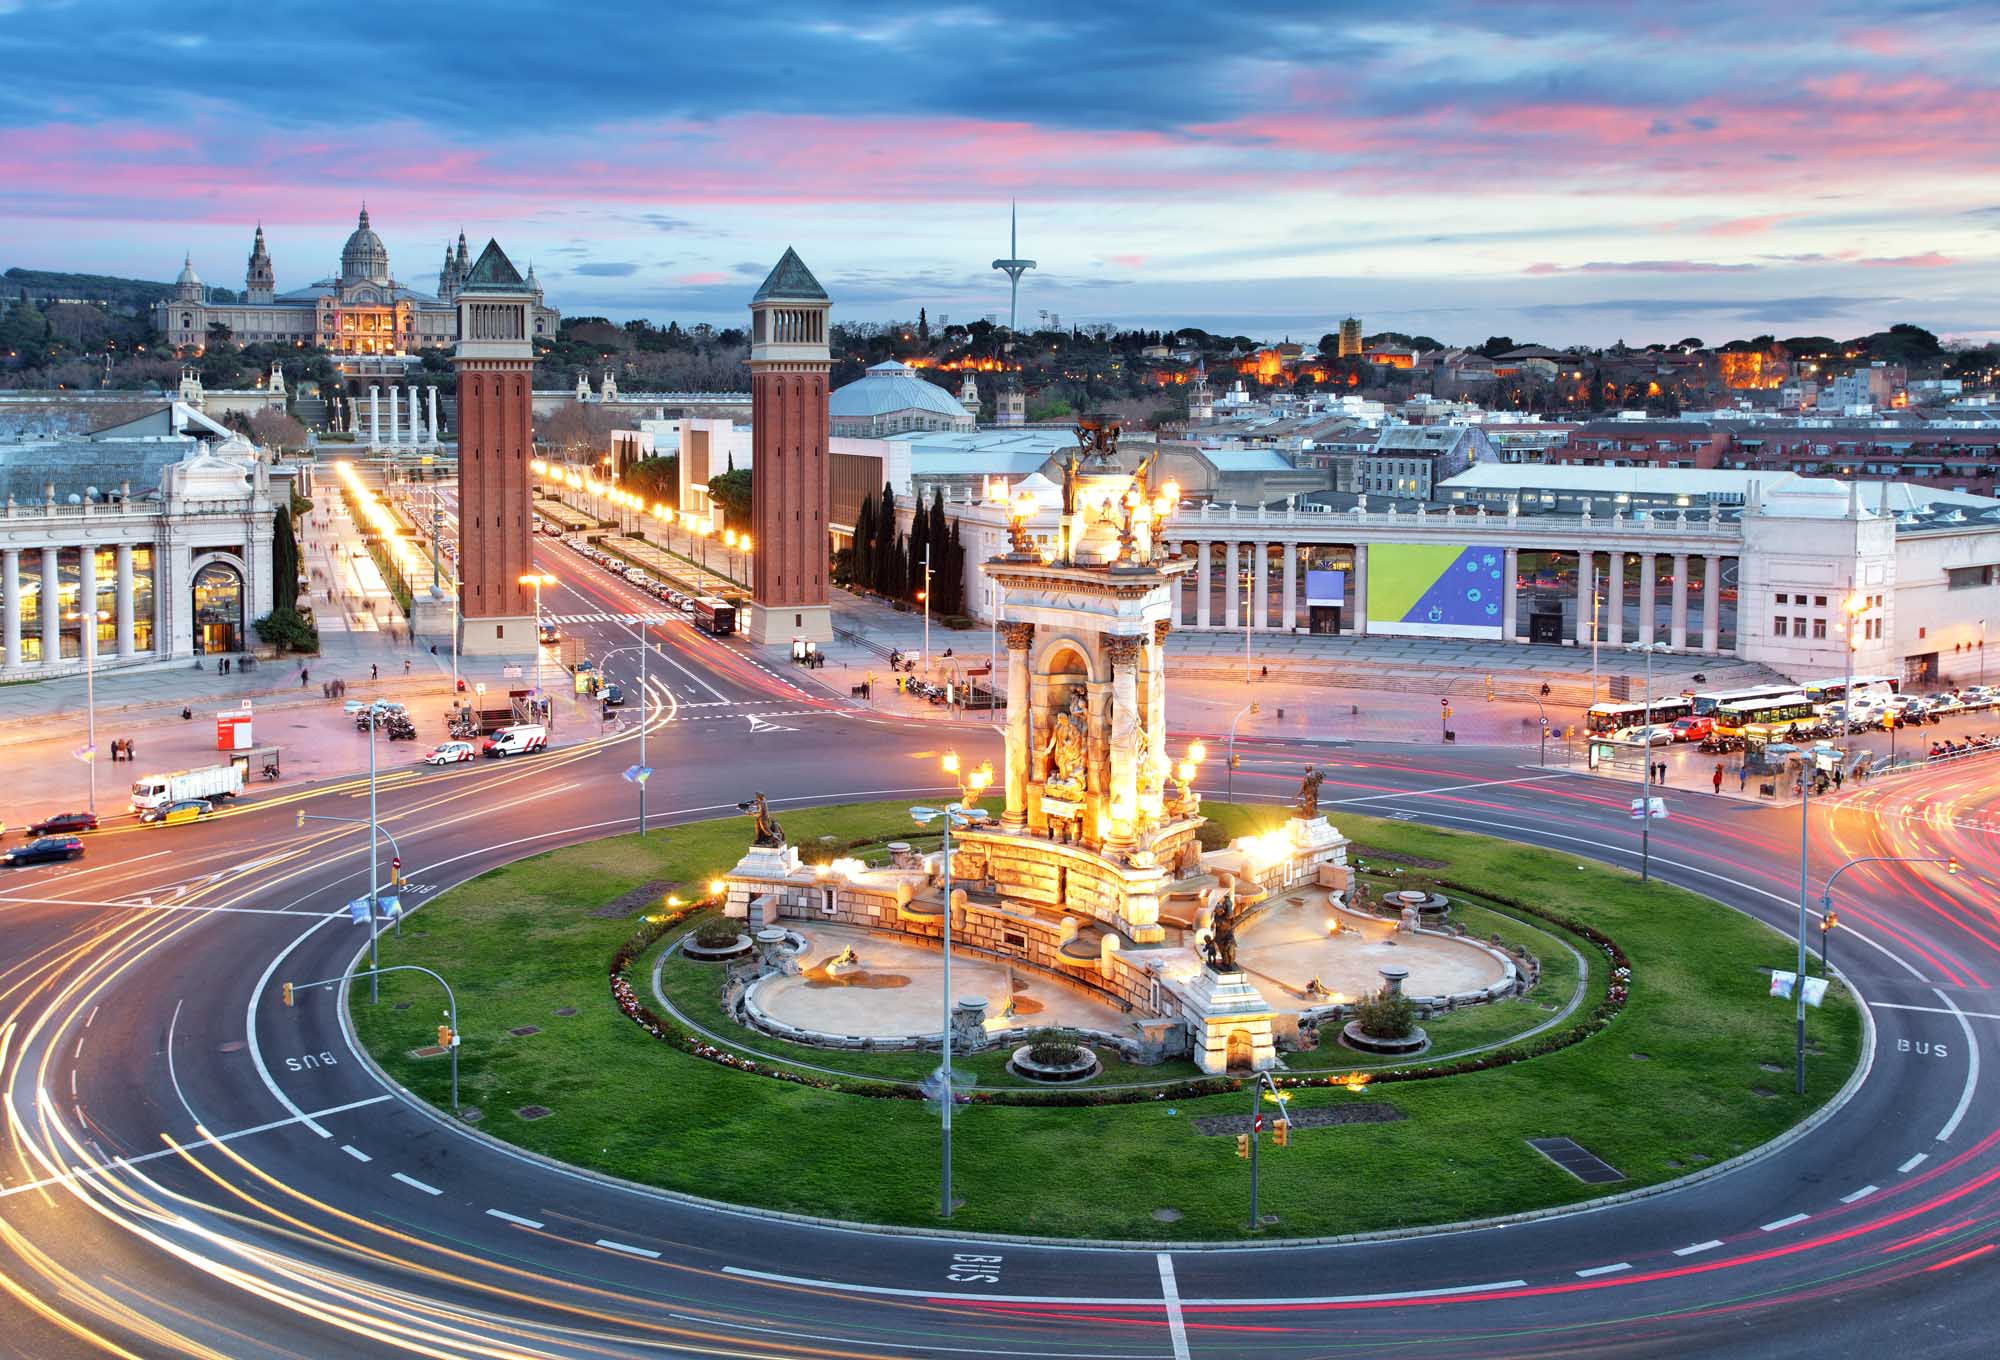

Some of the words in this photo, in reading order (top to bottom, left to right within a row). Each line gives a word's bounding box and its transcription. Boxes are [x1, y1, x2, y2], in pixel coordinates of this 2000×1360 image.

[399, 883, 438, 894] BUS
[1897, 1038, 1948, 1057] BUS
[285, 1051, 338, 1071] BUS
[946, 1253, 1004, 1284] BUS
